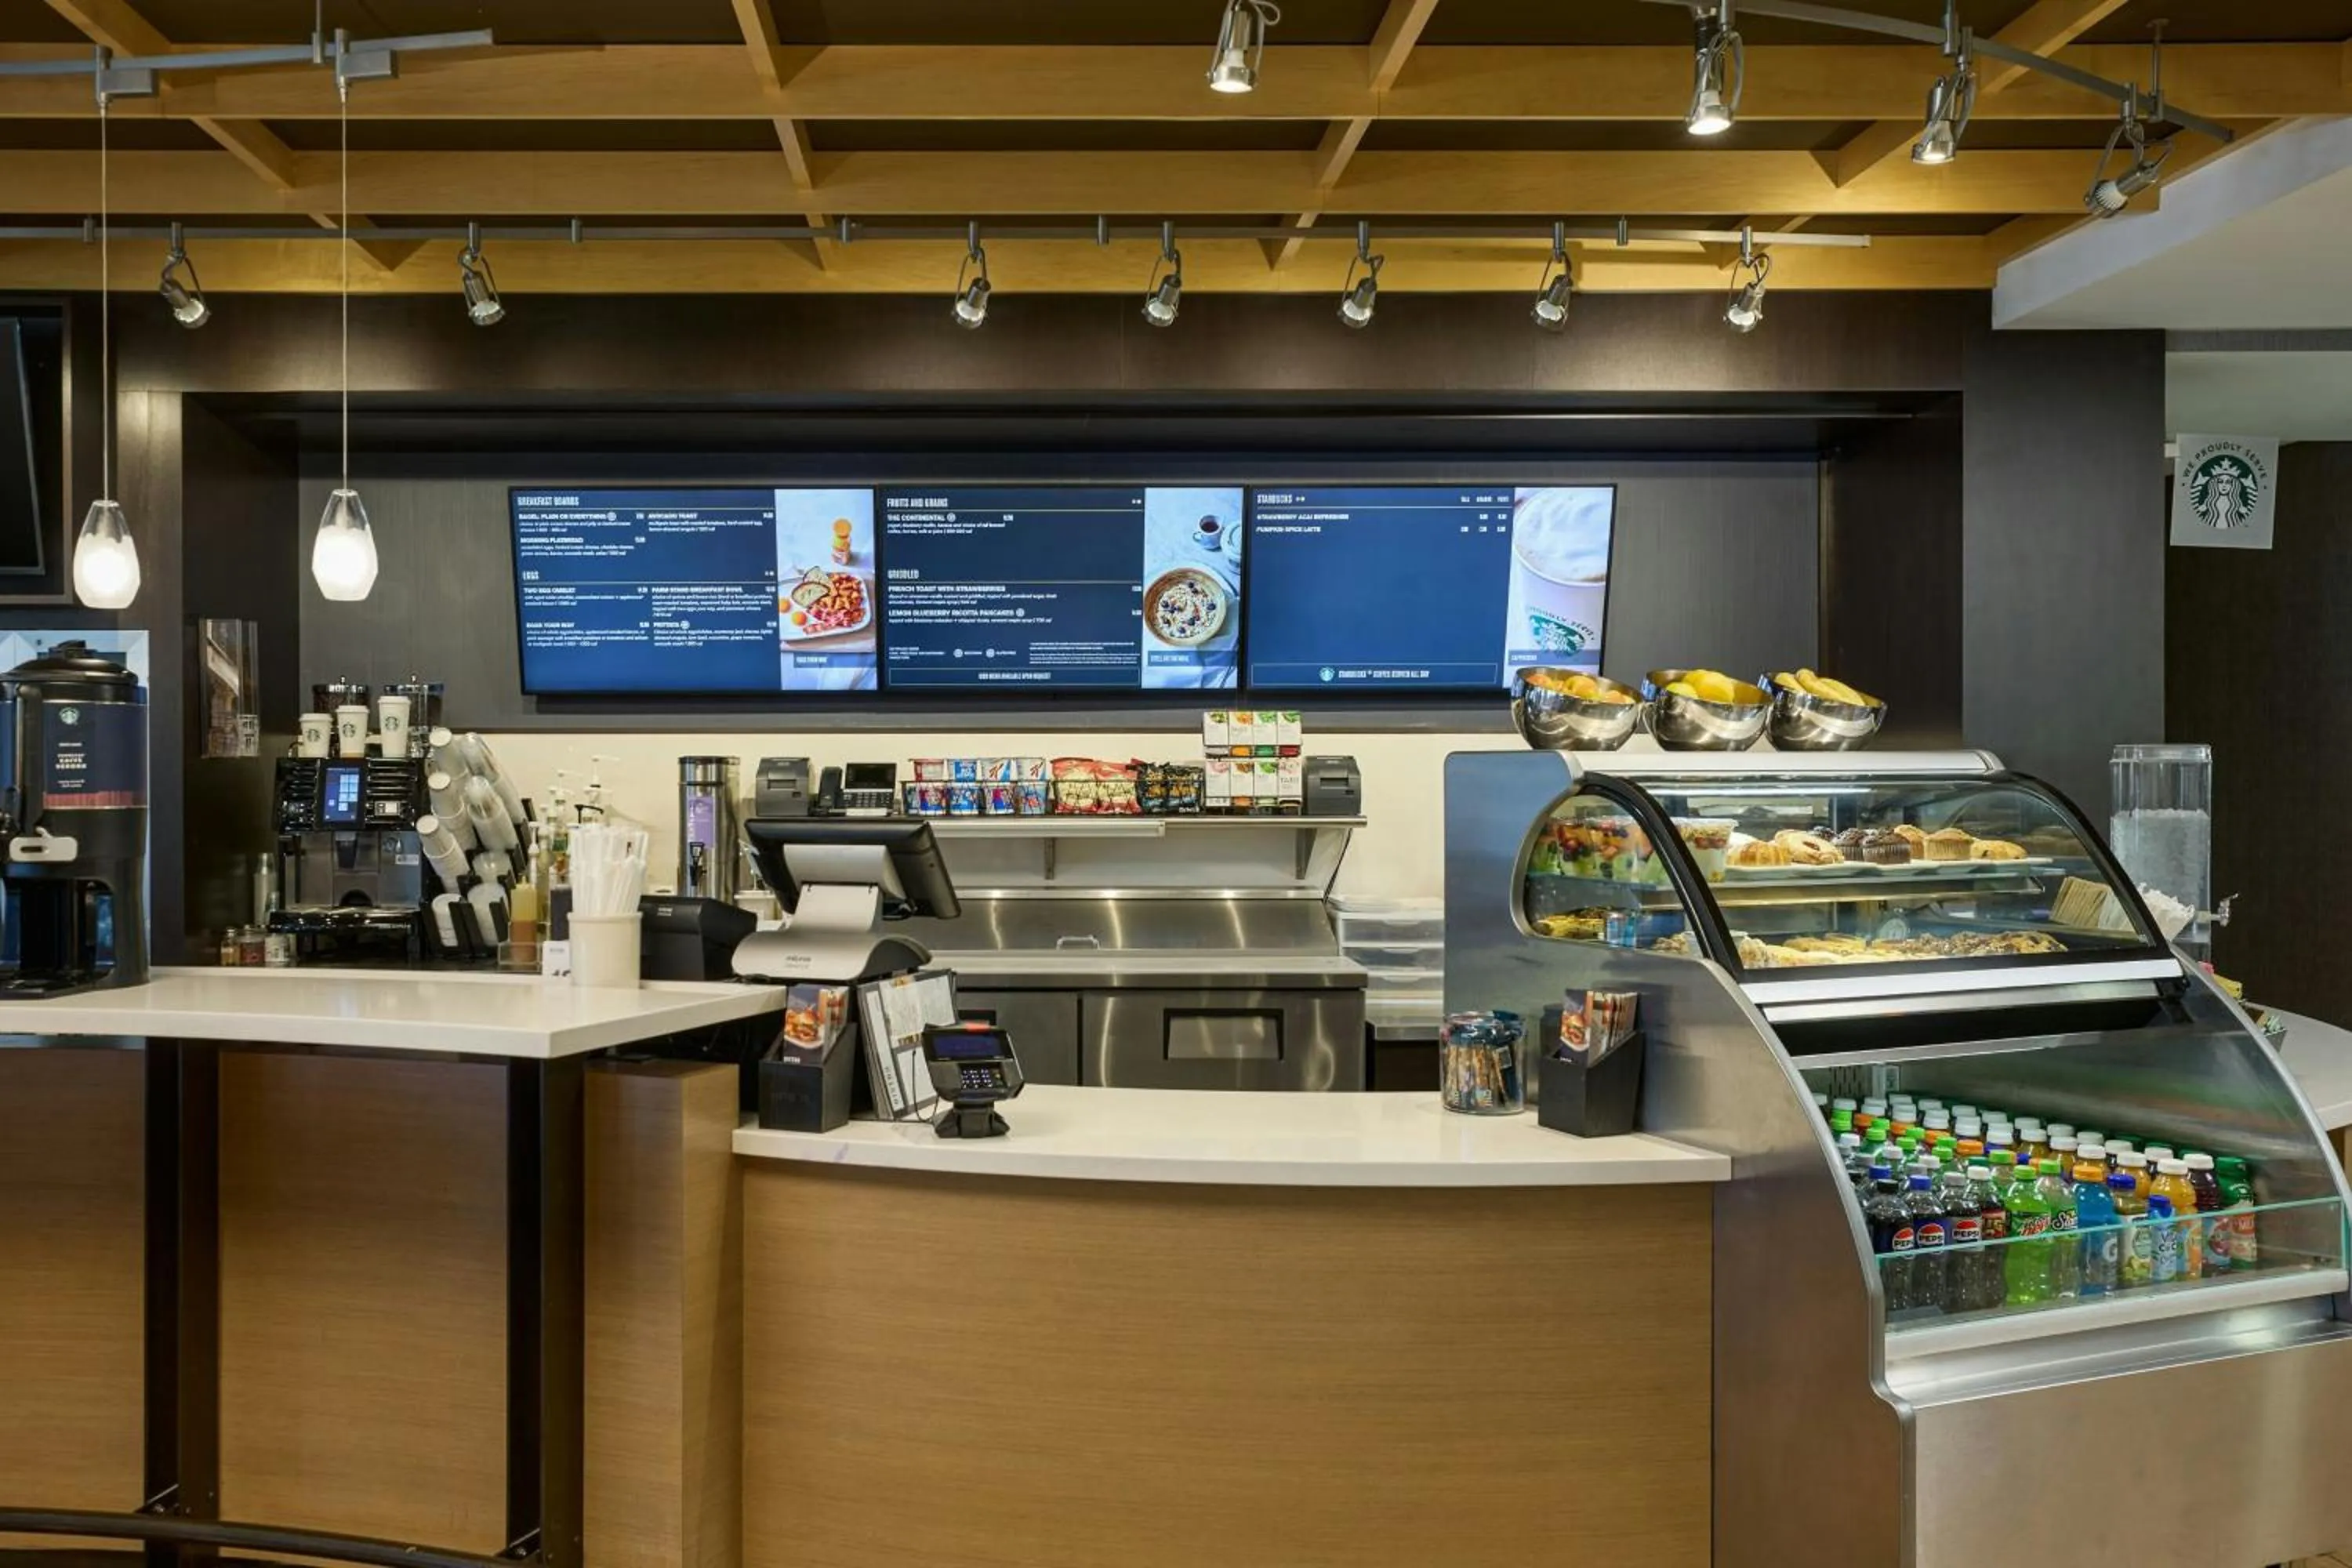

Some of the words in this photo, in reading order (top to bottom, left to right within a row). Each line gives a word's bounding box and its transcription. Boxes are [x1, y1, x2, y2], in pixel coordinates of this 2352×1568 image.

[2195, 441, 2241, 462] PROUDLY
[2245, 449, 2268, 479] SERVE
[517, 496, 553, 506] BREAKFAST
[887, 498, 909, 507] FRUITS
[910, 498, 924, 507] AND
[924, 498, 949, 507] GRAINS
[1257, 494, 1293, 504] STARBUCKS
[887, 569, 919, 579] GRIDDLED
